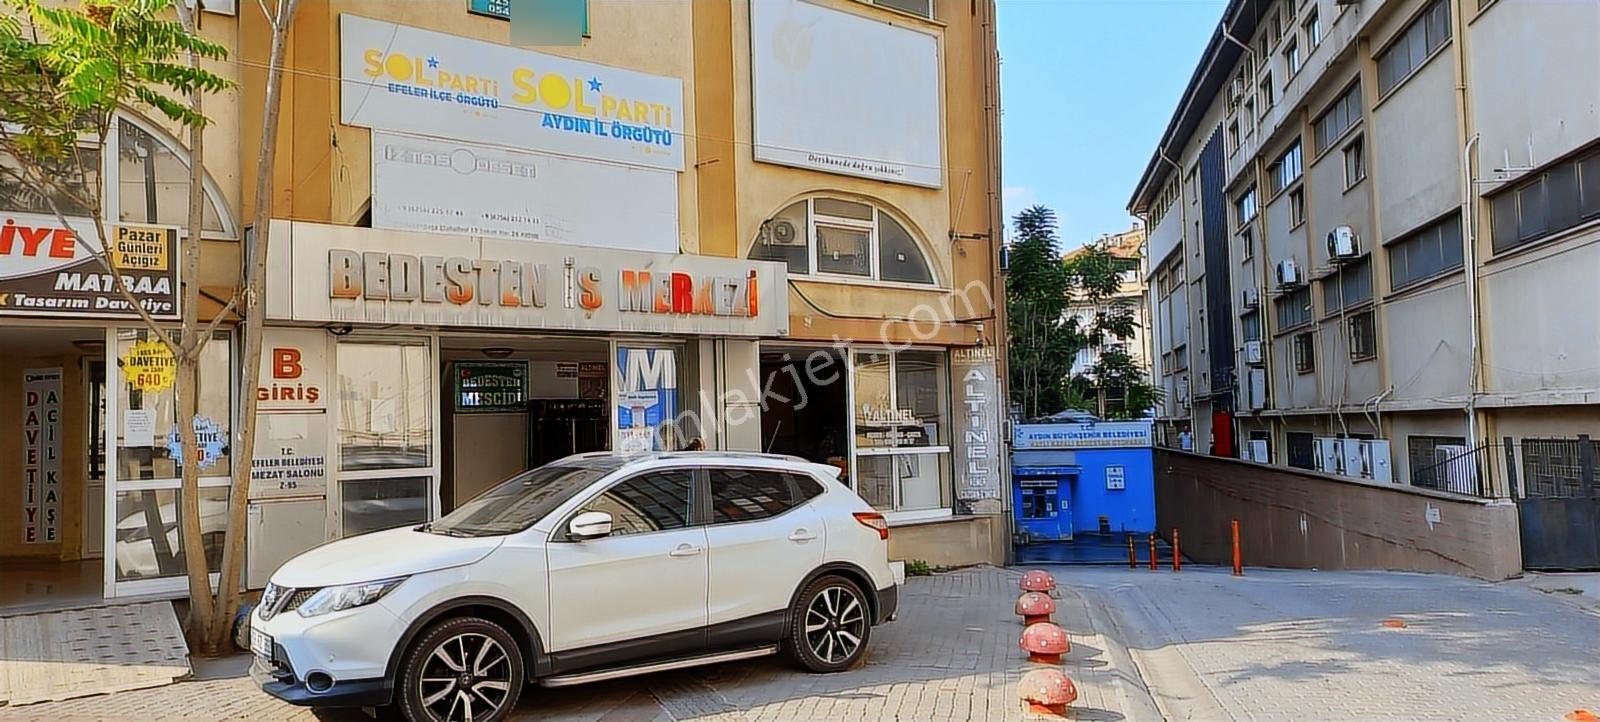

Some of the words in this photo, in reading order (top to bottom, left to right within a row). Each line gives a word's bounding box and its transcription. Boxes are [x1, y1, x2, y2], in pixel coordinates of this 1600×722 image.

[363, 49, 433, 88] SOL
[438, 71, 498, 97] PARTİ
[388, 83, 428, 98] EFELER
[512, 68, 597, 116] SOL
[602, 95, 672, 128] PARTİ
[542, 113, 591, 134] AYDIN
[594, 117, 608, 137] İL
[611, 120, 672, 146] ÖRGÜTÜ
[119, 227, 162, 243] Pazar
[118, 241, 163, 255] Günleri
[328, 249, 548, 308] BEDESTEN
[562, 257, 603, 318] İŞ
[618, 269, 759, 318] MERKEZİ
[14, 294, 89, 308] Tasarım
[273, 348, 302, 380] B
[138, 373, 160, 386] 640
[462, 374, 521, 388] BEDESTEN
[257, 383, 320, 403] GİRİŞ
[462, 388, 521, 406] MESCİDİ
[963, 369, 988, 474] ALTINEL
[286, 469, 324, 478] SALONU
